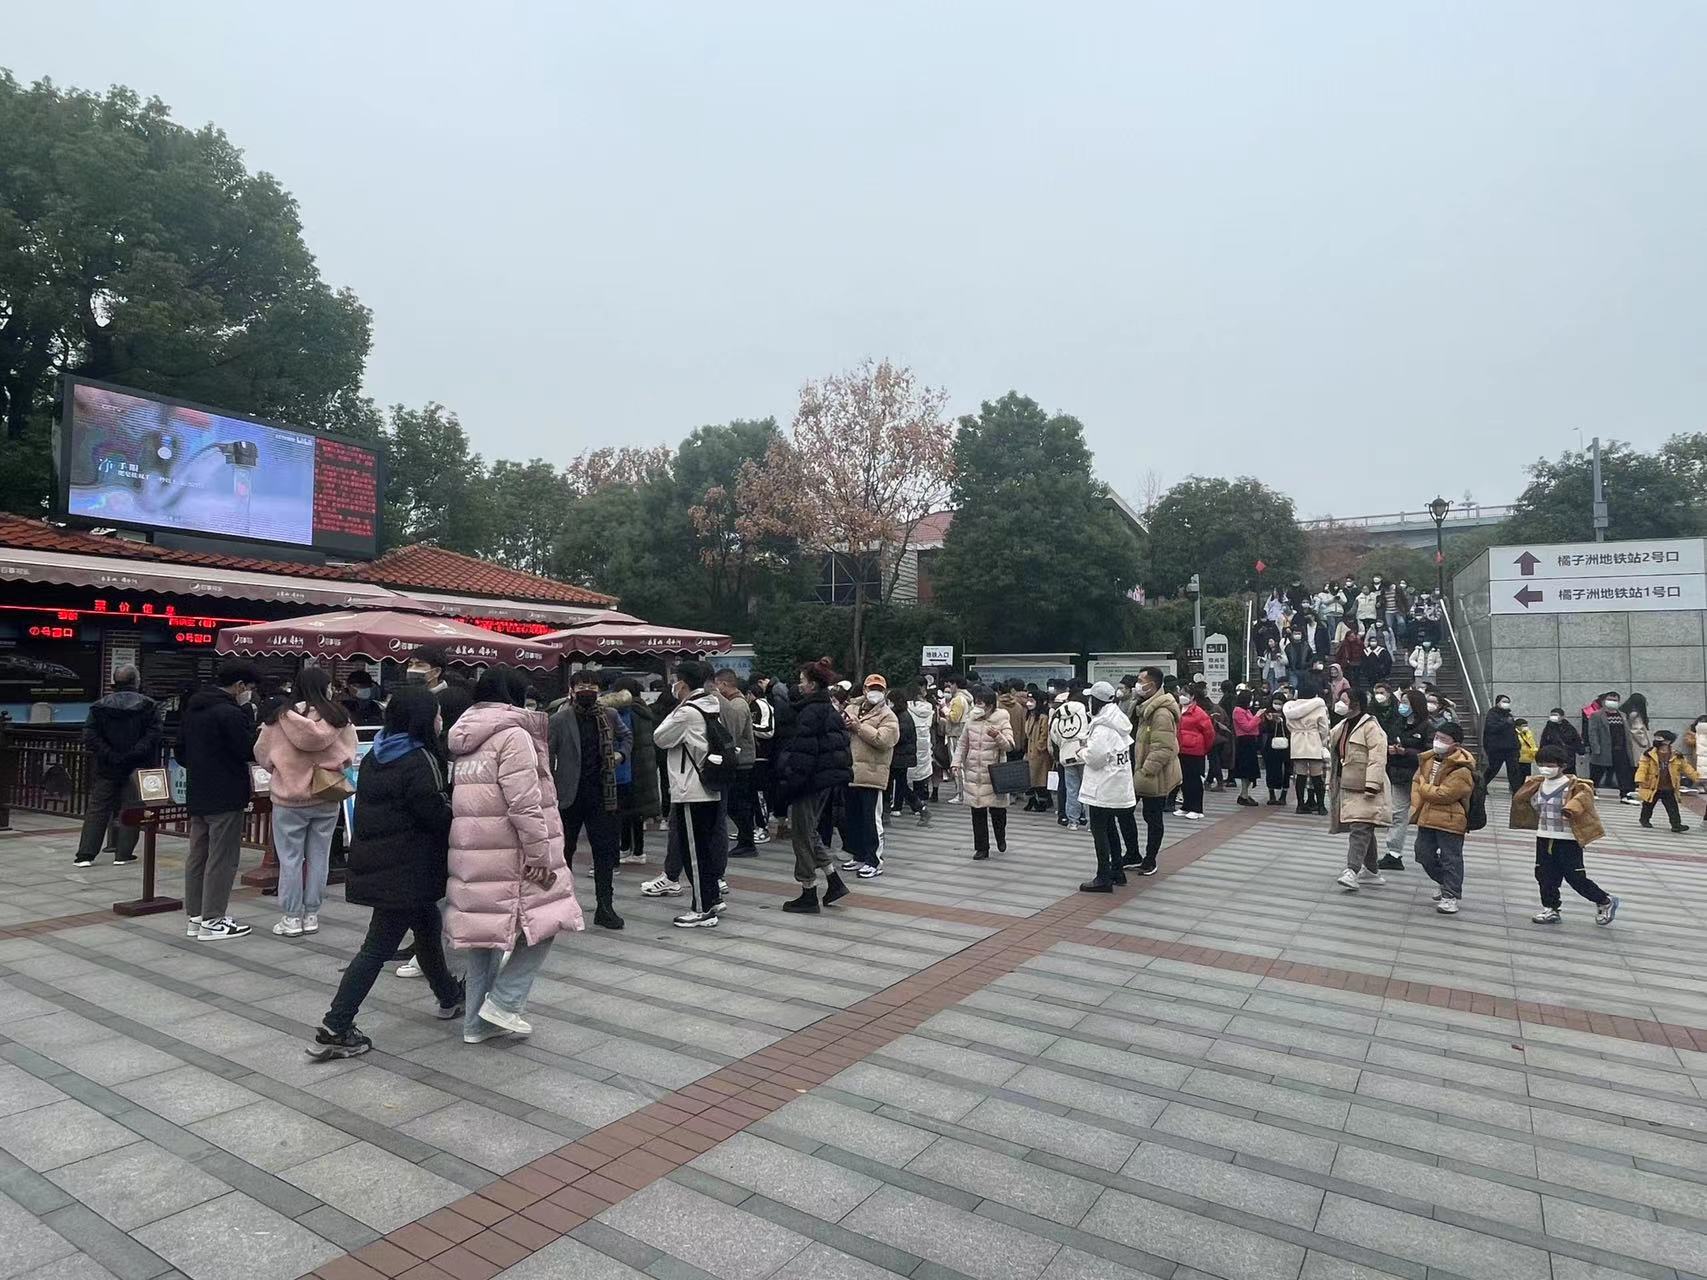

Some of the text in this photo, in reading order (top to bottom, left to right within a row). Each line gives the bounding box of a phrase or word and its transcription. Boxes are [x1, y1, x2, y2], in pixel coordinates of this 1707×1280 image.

[1558, 551, 1679, 566] 橘子洲地铁站2号口
[1559, 586, 1681, 600] 橘子洲地铁站1号口
[926, 651, 950, 659] 地铁入口
